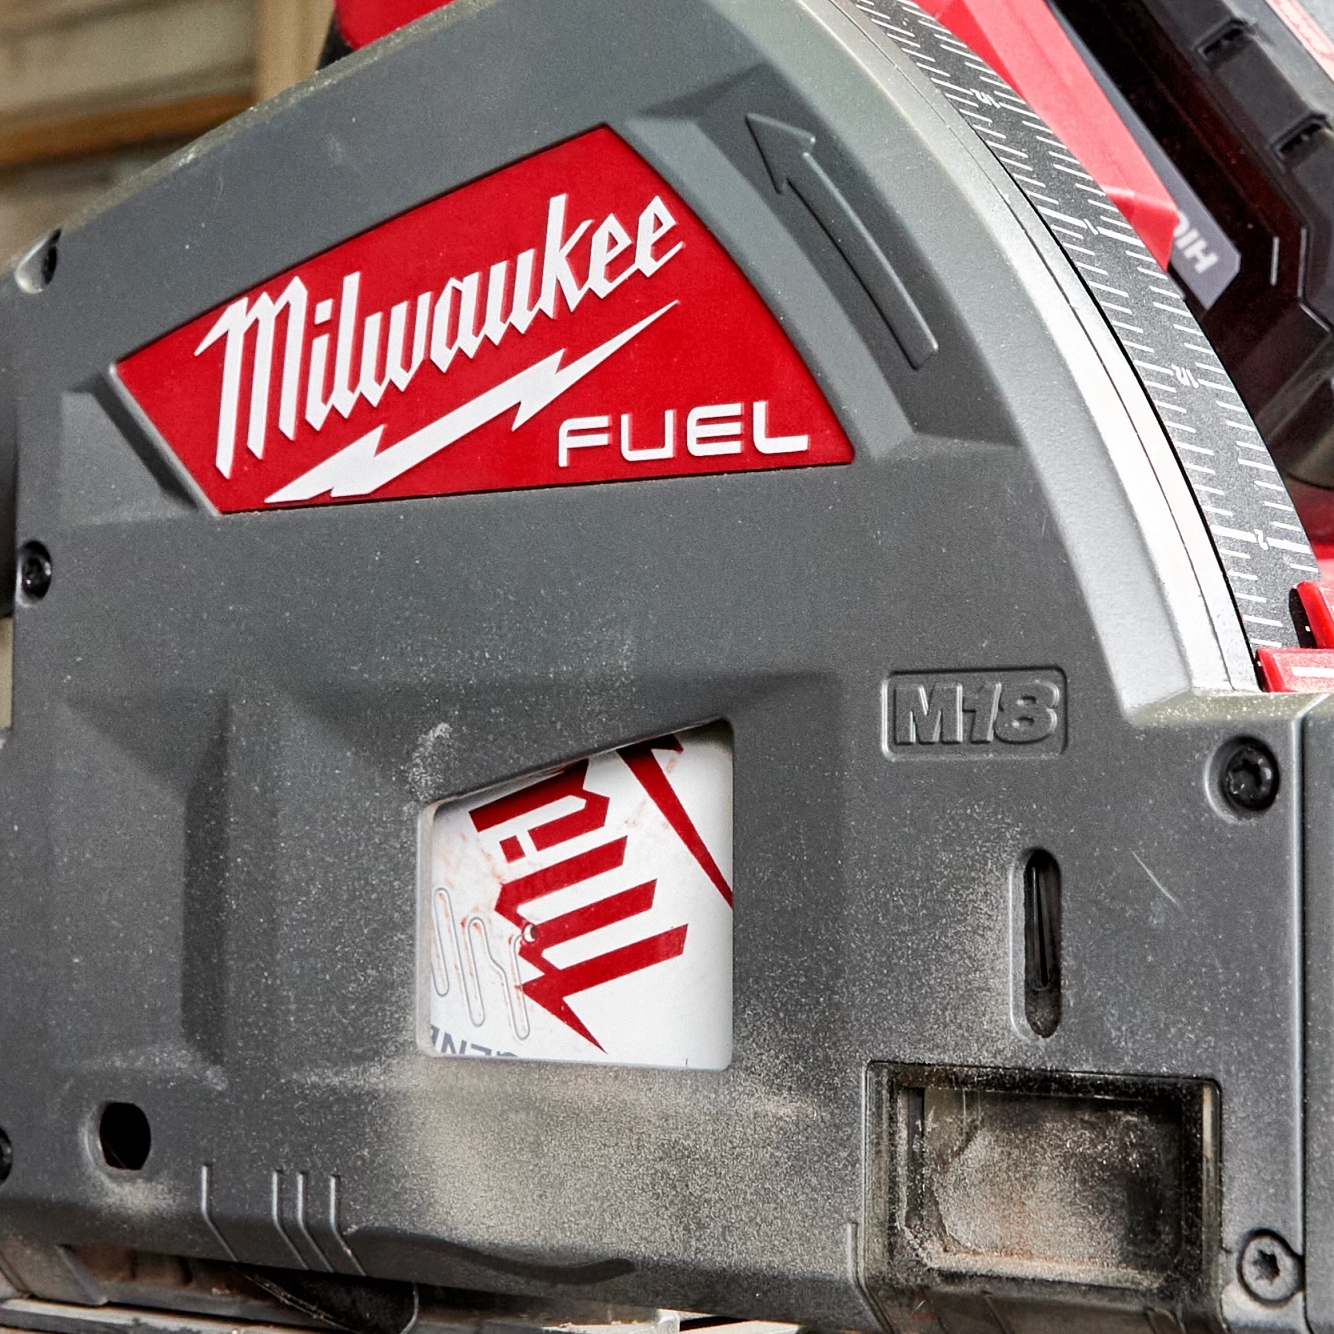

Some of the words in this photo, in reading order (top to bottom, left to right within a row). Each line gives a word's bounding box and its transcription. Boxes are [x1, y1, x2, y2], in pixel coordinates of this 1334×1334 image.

[194, 193, 684, 479] Milwaukee
[558, 401, 809, 468] FUEL
[893, 679, 1060, 745] M18
